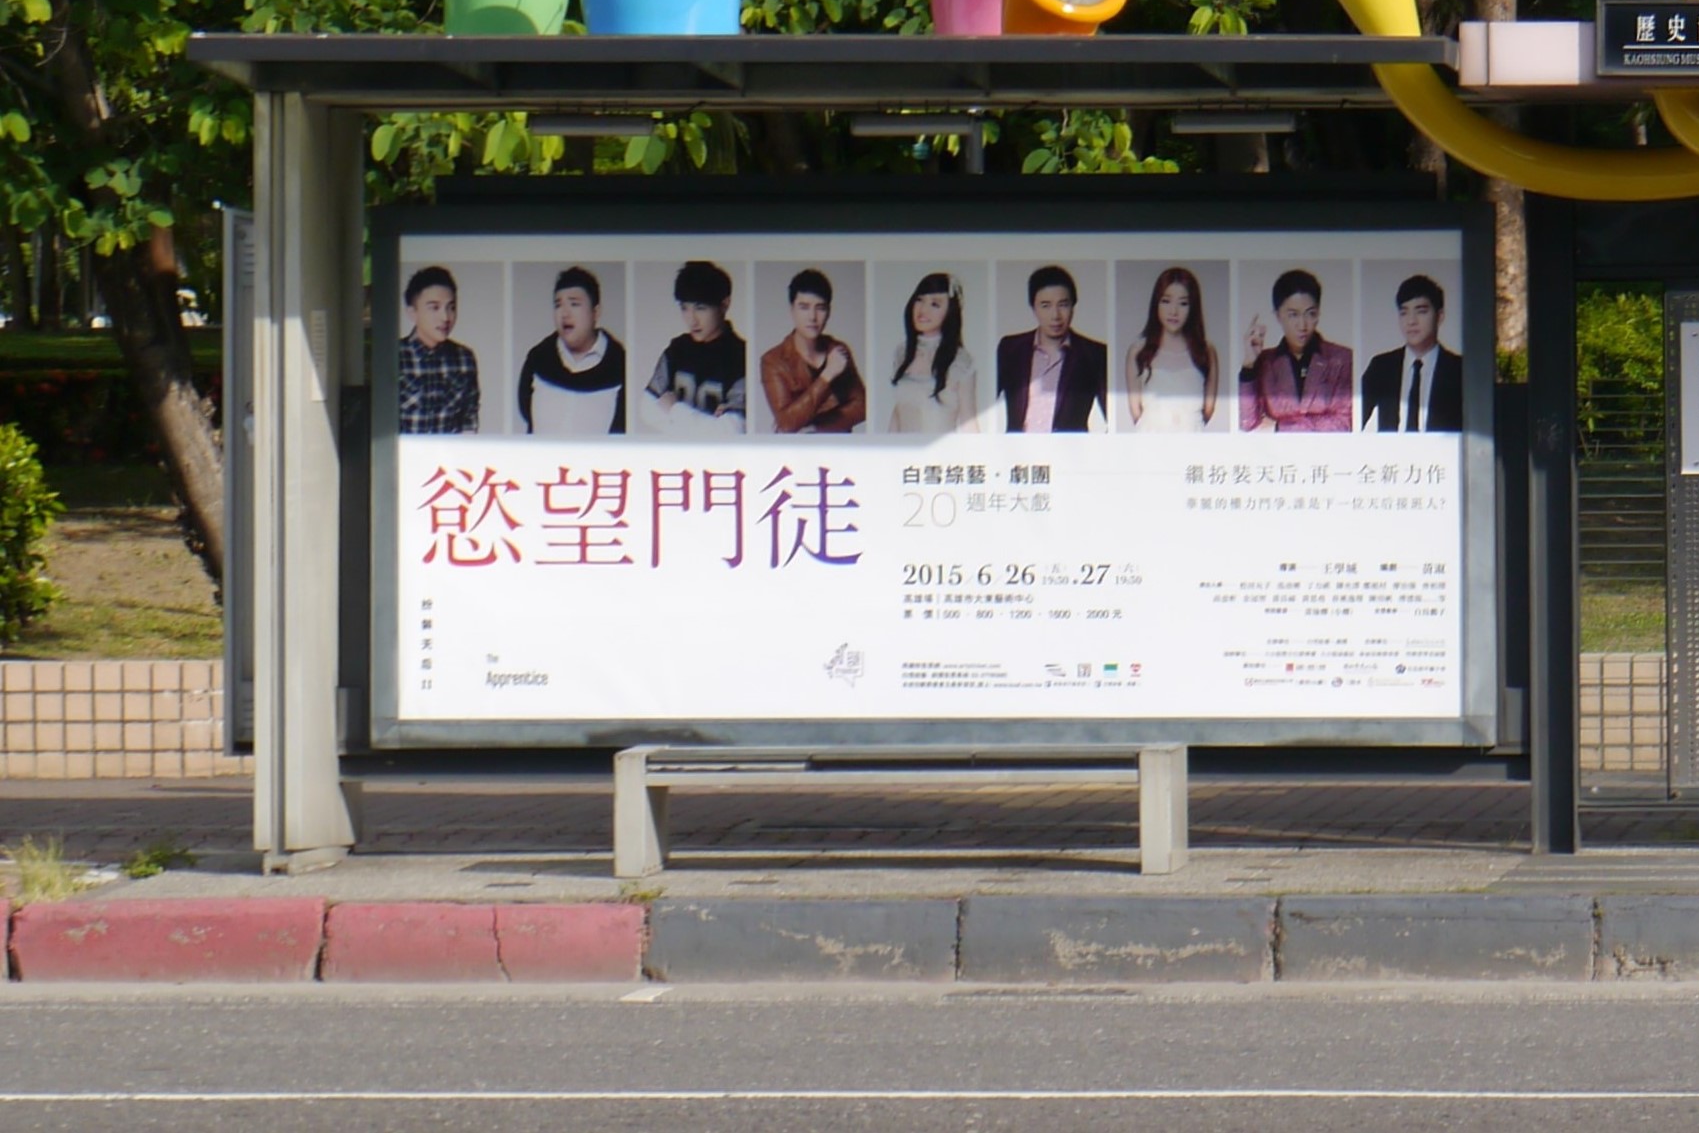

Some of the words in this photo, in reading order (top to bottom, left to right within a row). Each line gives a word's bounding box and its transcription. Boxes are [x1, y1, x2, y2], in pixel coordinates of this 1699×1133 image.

[1623, 53, 1680, 65] KAOHSIUNG
[416, 464, 864, 569] 慾望門徒
[902, 491, 957, 528] 20
[966, 492, 1052, 513] 週年大戲
[485, 670, 549, 688] Apprentice
